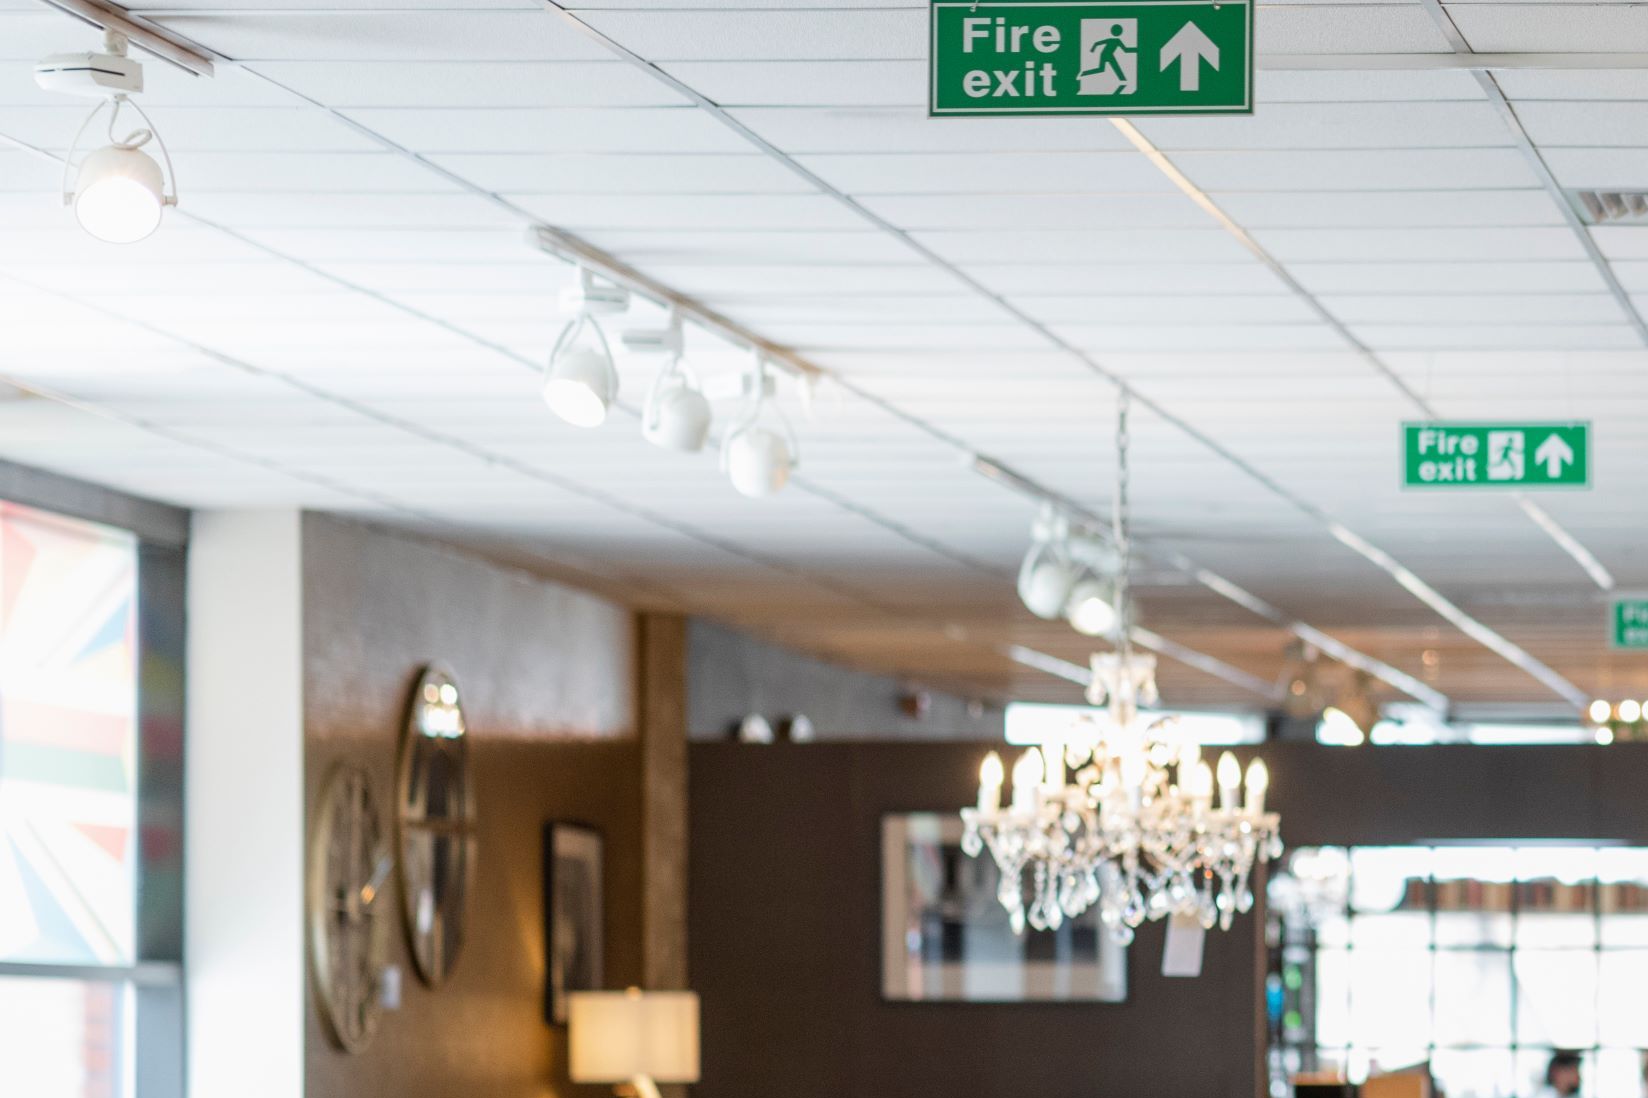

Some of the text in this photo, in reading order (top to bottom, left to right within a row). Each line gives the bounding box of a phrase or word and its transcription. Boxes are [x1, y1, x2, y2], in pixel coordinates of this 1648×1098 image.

[963, 17, 1061, 53] Fire
[963, 61, 1057, 97] exit
[1418, 429, 1479, 455] Fire
[1418, 456, 1477, 481] exit
